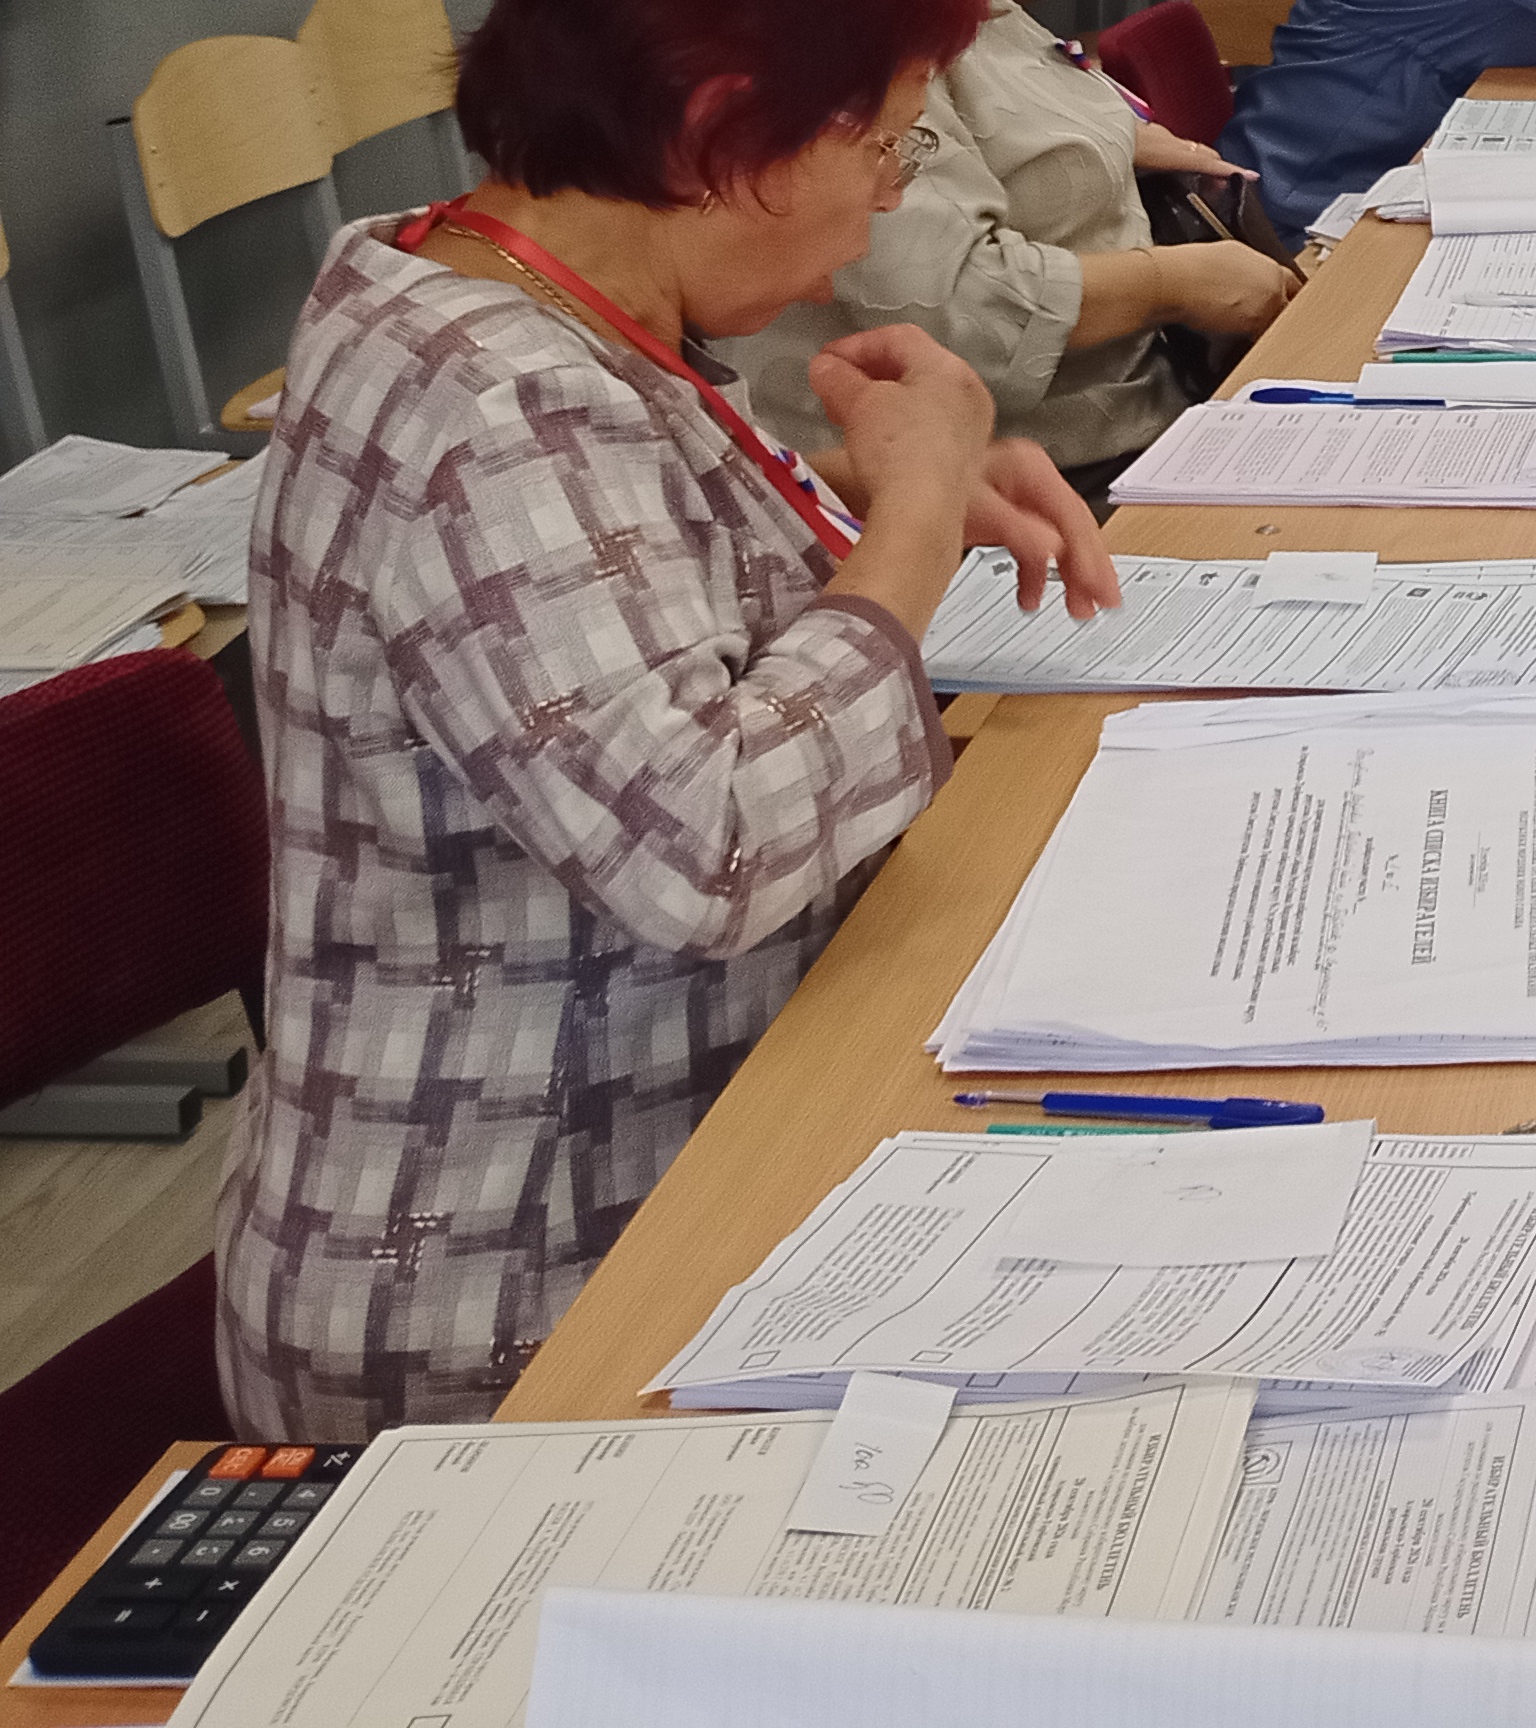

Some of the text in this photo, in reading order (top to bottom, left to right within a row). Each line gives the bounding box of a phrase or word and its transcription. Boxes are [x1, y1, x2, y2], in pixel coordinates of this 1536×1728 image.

[1411, 789, 1449, 965] КНИГА СПИСКА ИЗБИРАТЕЛЕЙ
[1096, 1434, 1163, 1591] ИЗБИРАТЕЛЬНЫЙ БЮЛЛЕТЕНЬ
[1456, 1455, 1506, 1619] ИЗБИРАТЕЛЬНЫЙ БЮЛЛЕТЕНЬ
